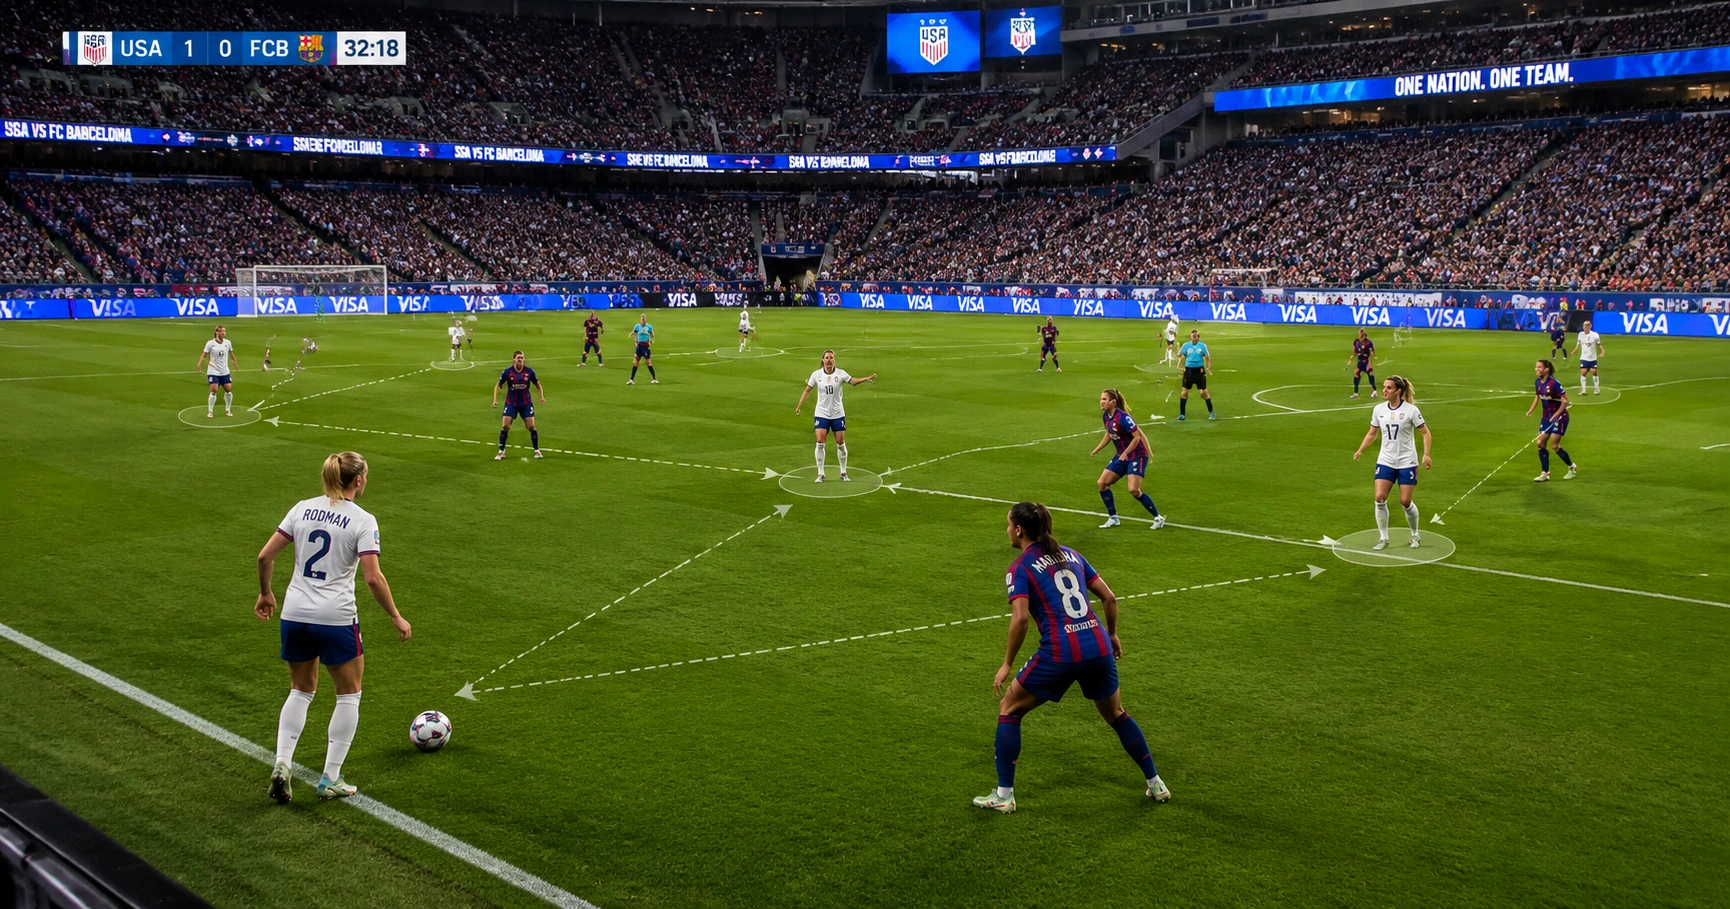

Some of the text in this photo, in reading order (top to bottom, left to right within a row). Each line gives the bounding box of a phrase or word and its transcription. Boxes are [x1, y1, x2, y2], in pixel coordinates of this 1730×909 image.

[922, 28, 945, 43] USA
[1395, 62, 1574, 96] ONE NATION. ONE TEAM.
[31, 122, 47, 138] VS
[48, 123, 64, 139] FC
[88, 298, 137, 317] VISA
[170, 298, 219, 316] VISA
[256, 297, 298, 314] VISA
[329, 296, 369, 313] VISA
[859, 293, 885, 309] VISA
[907, 294, 933, 311] VISA
[957, 295, 985, 312] VISA
[1011, 297, 1041, 314] VISA
[1138, 300, 1174, 318] VISA
[1210, 302, 1247, 321] VISA
[1277, 304, 1317, 323] VISA
[1349, 306, 1391, 325] VISA
[1424, 308, 1466, 328] VISA
[1619, 312, 1668, 335] VISA
[824, 385, 834, 395] 10
[1385, 424, 1400, 440] 17
[302, 508, 350, 530] RODMAN
[303, 529, 332, 581] 2
[1054, 569, 1088, 619] 8
